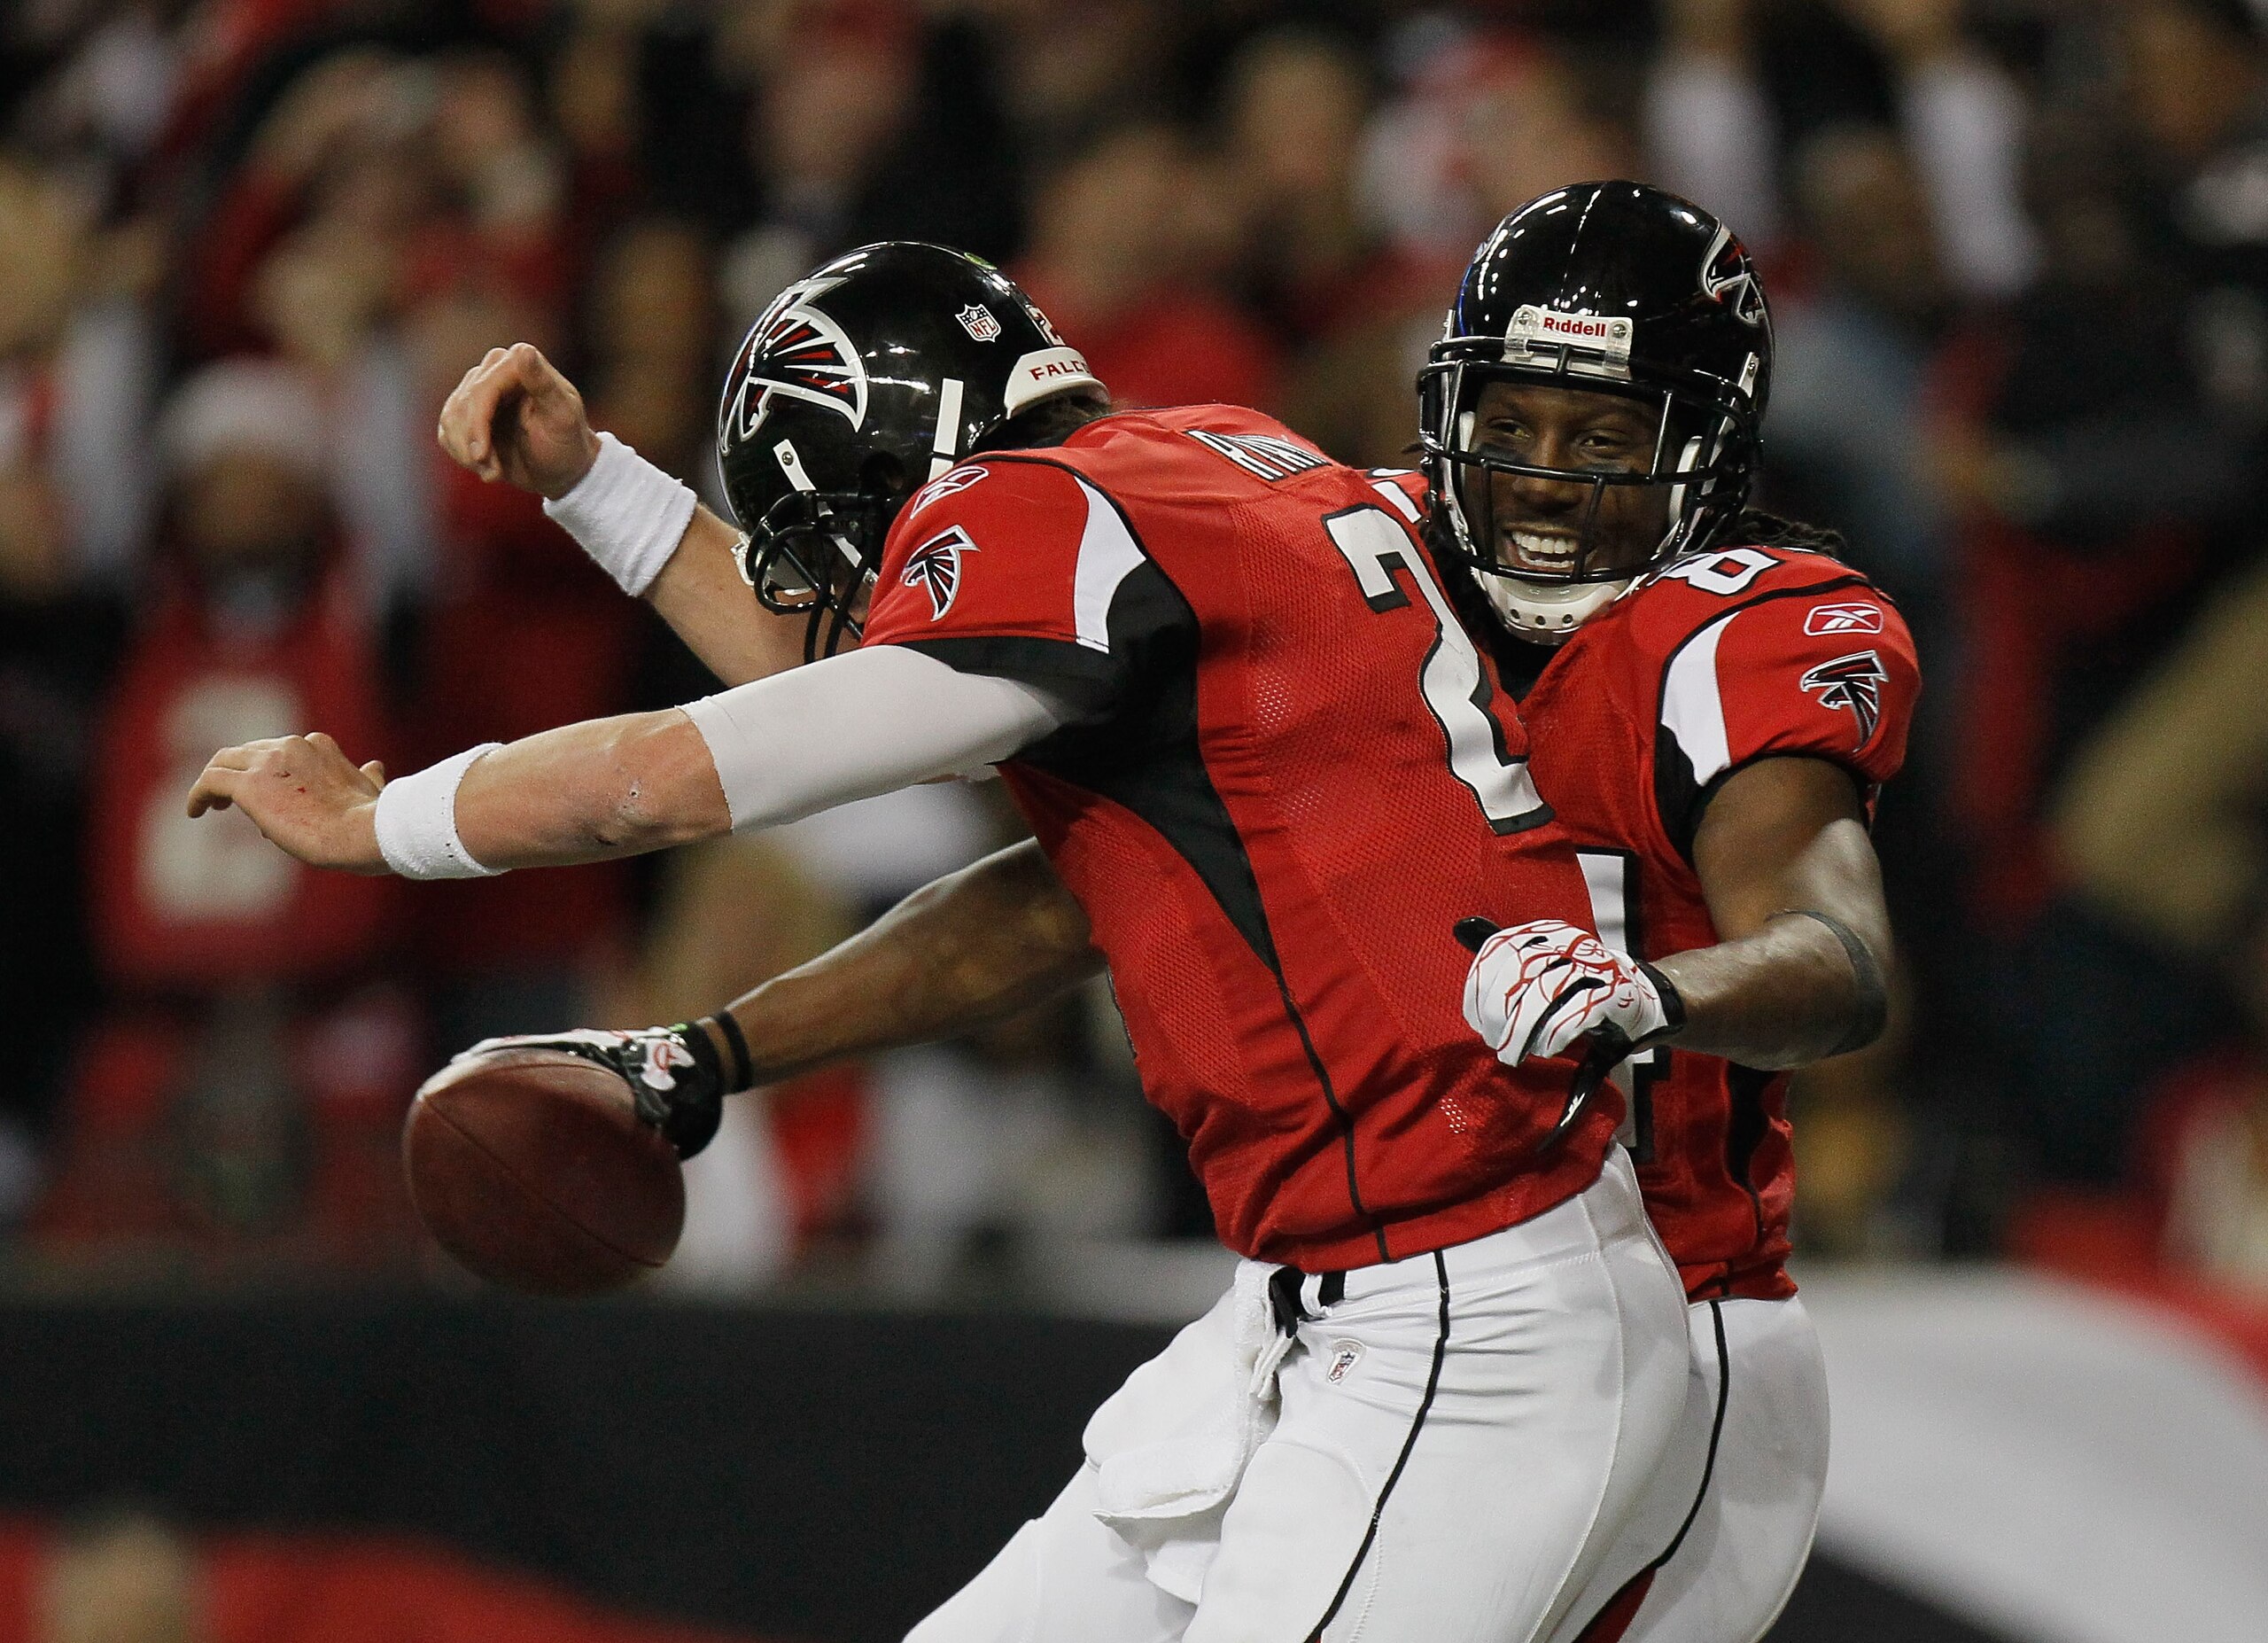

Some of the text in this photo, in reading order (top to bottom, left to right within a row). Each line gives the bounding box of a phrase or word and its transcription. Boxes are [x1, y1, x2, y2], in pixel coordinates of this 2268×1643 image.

[970, 318, 997, 337] NFL
[1542, 316, 1607, 338] Riddell
[1322, 503, 1552, 831] 2
